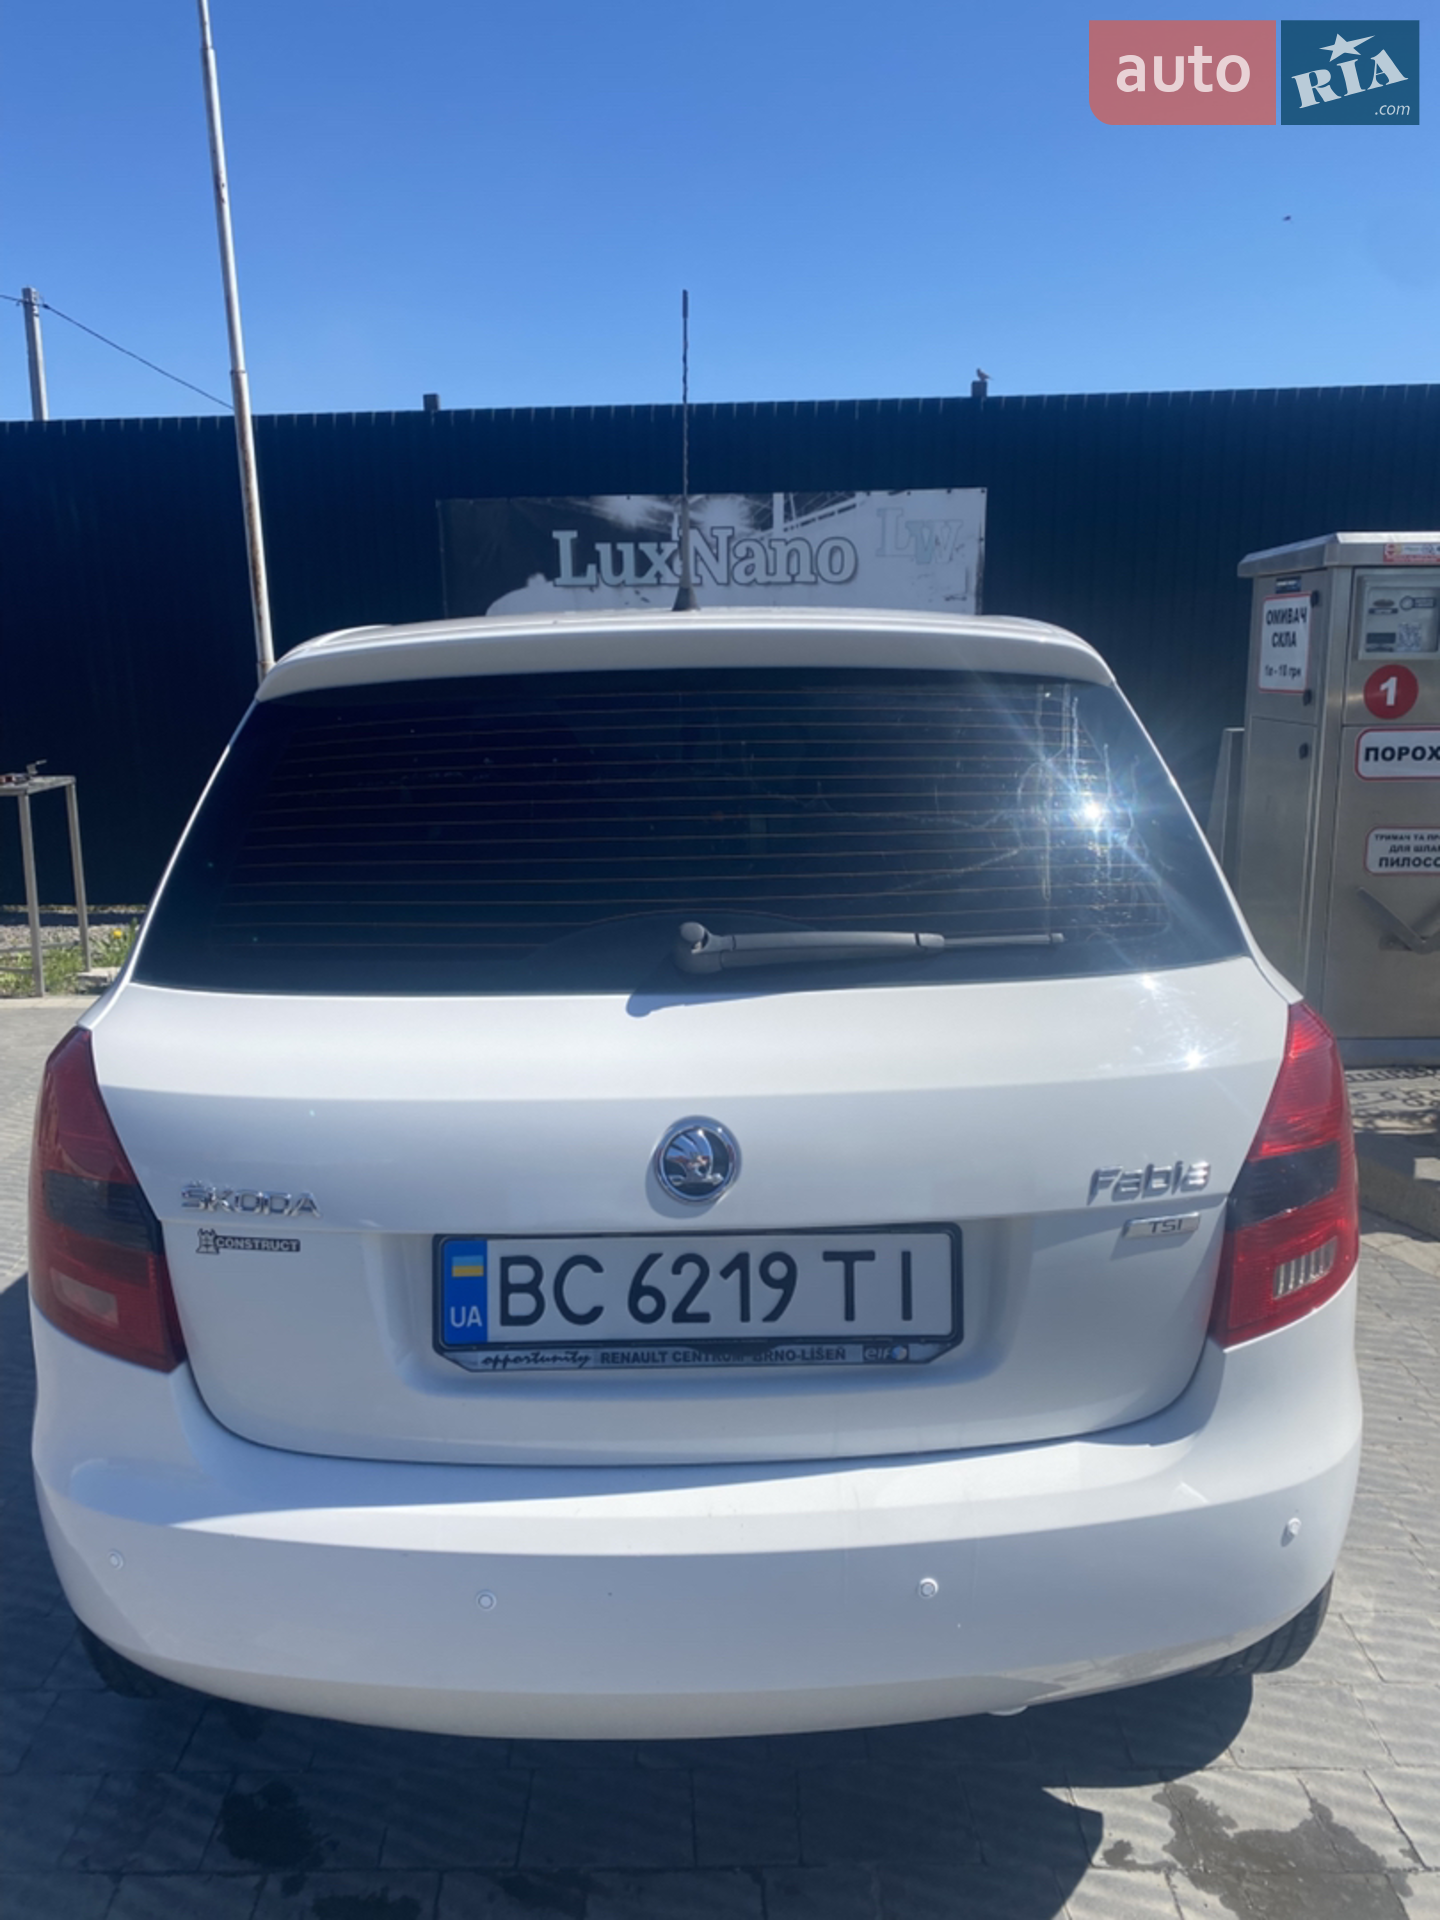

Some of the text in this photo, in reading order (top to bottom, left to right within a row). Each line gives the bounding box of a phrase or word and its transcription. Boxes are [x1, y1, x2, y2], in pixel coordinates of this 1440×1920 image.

[552, 526, 859, 588] LuxNano
[1265, 606, 1307, 626] ОМИВАЧ
[1271, 631, 1297, 648] СКЛА
[1380, 677, 1398, 706] 1
[1364, 746, 1440, 762] ПОРОХ
[1374, 833, 1411, 841] ТРИМАЧ
[1413, 833, 1425, 841] ТА
[1388, 844, 1411, 854] ДЛЯ
[1086, 1161, 1211, 1206] Fabia
[1149, 1219, 1183, 1233] TSI
[215, 1237, 299, 1251] CONSTRUCT
[500, 1250, 913, 1326] BC 6219 TI
[450, 1305, 483, 1328] UA
[481, 1351, 591, 1369] opportunity
[600, 1351, 668, 1365] RENAULT
